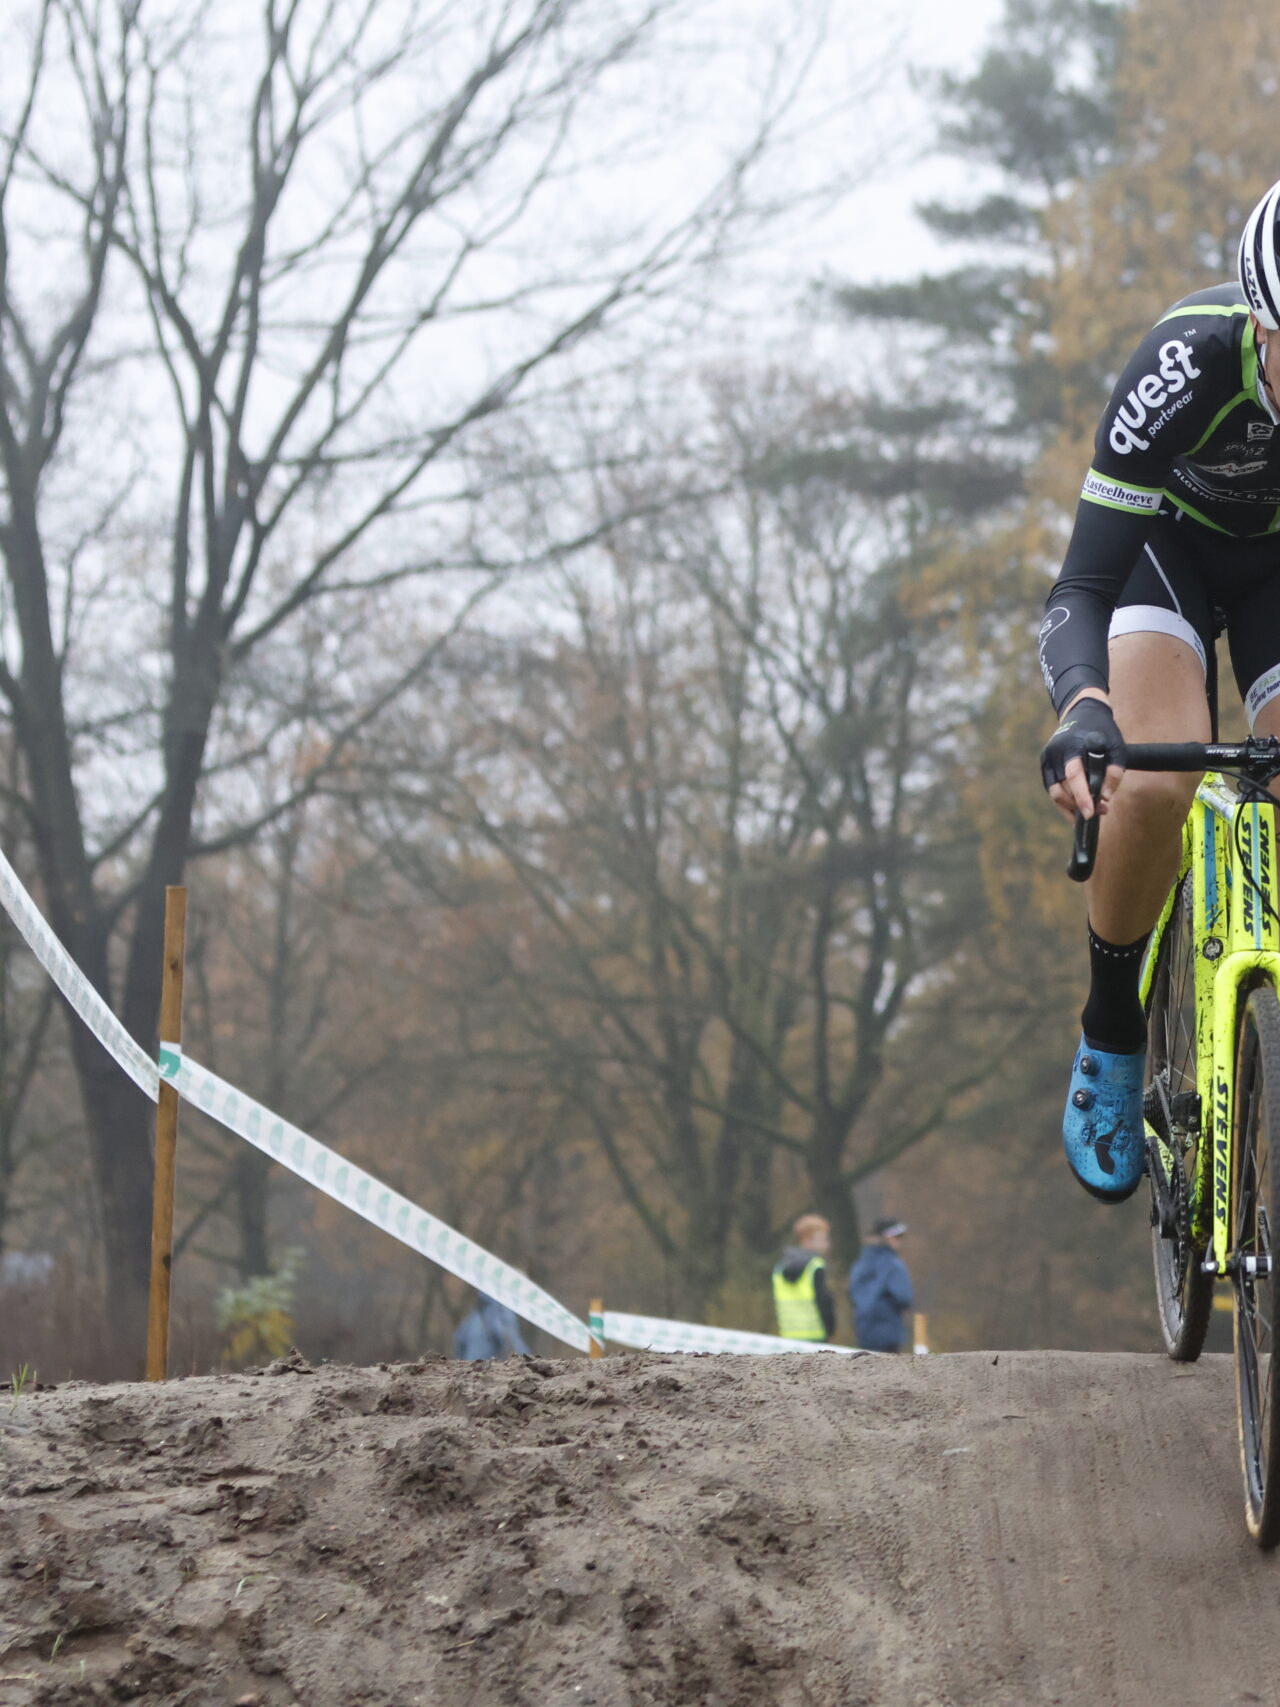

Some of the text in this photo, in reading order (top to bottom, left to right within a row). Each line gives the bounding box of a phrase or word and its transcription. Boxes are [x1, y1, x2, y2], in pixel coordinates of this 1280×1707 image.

[1109, 339, 1201, 455] quest
[1259, 814, 1272, 937] STEVENS
[1216, 1075, 1229, 1226] STEVENS
